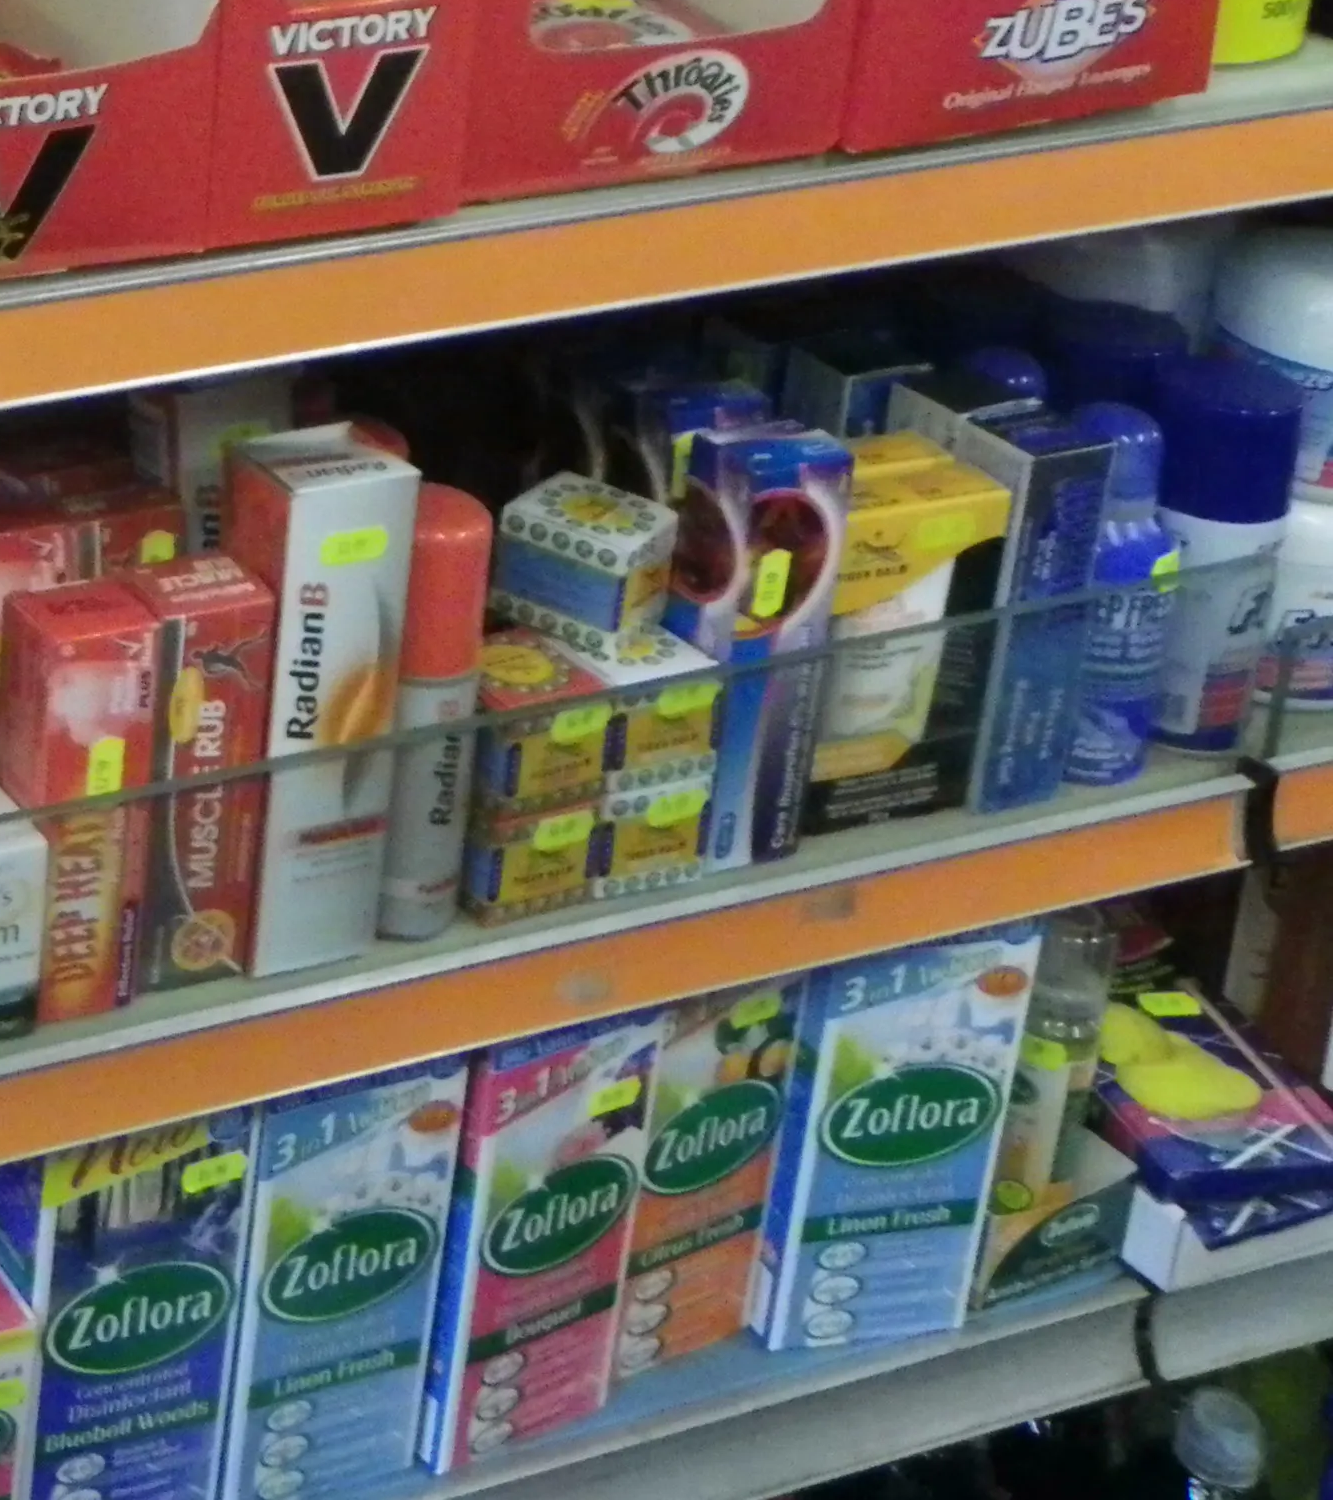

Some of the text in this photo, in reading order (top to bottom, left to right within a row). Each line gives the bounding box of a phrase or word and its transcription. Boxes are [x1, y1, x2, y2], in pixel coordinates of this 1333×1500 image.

[270, 6, 436, 55] VICTORY
[942, 86, 1014, 111] Original
[286, 581, 330, 742] Radian B
[194, 700, 226, 758] RUB
[53, 900, 93, 984] DEEP
[654, 1105, 767, 1174] Zoflora
[840, 1096, 981, 1140] Zoflora
[501, 1183, 621, 1253] Zoflora
[826, 1205, 951, 1238] Linen Fresh
[280, 1236, 419, 1302] Zoflora
[67, 1289, 213, 1353] Zoflora
[273, 1349, 396, 1397] Linen Fresh
[44, 1400, 210, 1453] Bluebell Woods
